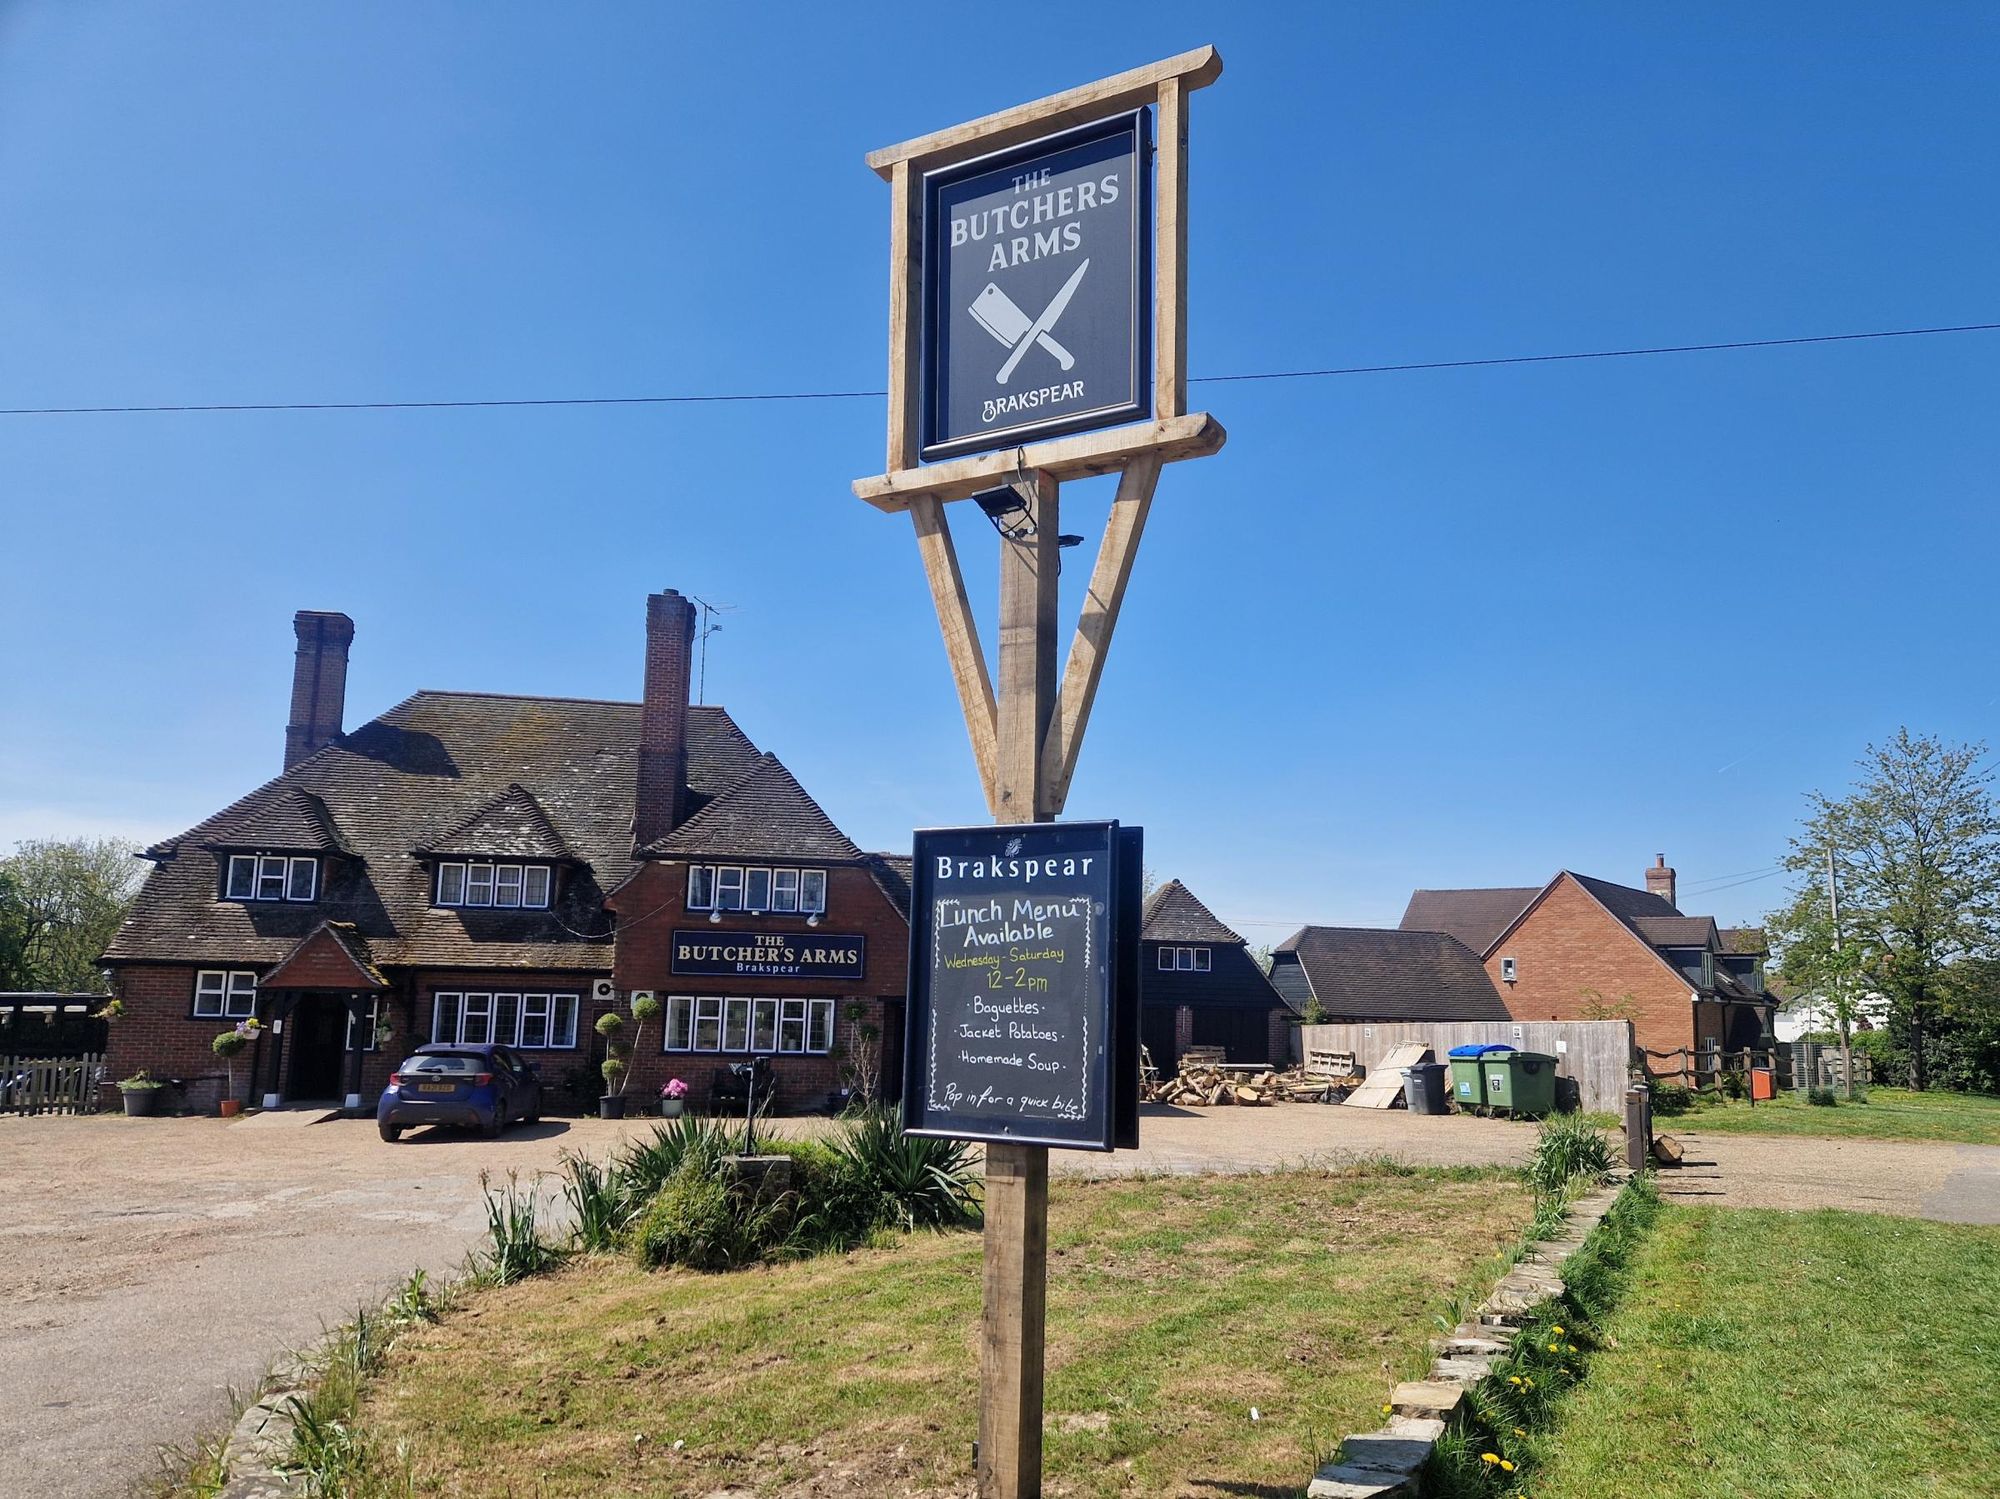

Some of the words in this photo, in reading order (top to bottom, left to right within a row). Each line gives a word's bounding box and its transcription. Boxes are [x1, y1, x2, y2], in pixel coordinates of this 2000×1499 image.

[1012, 168, 1051, 194] THE
[950, 174, 1119, 247] BUTCHERS
[987, 221, 1081, 272] ARMS
[982, 381, 1084, 422] BRAKSPEAR
[936, 855, 1093, 883] Brakspear
[940, 900, 1002, 928] Lunch
[1012, 900, 1080, 922] Menu
[755, 935, 785, 947] THE
[963, 922, 1054, 947] Available
[677, 945, 794, 963] BUTCHER'S
[800, 948, 858, 965] ARMS
[736, 962, 800, 974] Brakspear
[944, 951, 1000, 969] Wednesday
[1009, 947, 1064, 963] Saturday
[973, 995, 1040, 1022] Baguettes
[959, 1024, 1001, 1039] Jacket
[1009, 1021, 1058, 1042] Potatoes
[961, 1050, 1023, 1067] Homemade
[1028, 1053, 1060, 1074] Soup
[944, 1082, 962, 1107] Pop
[976, 1085, 1003, 1108] for
[1006, 1096, 1014, 1106] a
[1019, 1096, 1048, 1112] quick
[1051, 1094, 1079, 1115] bite
